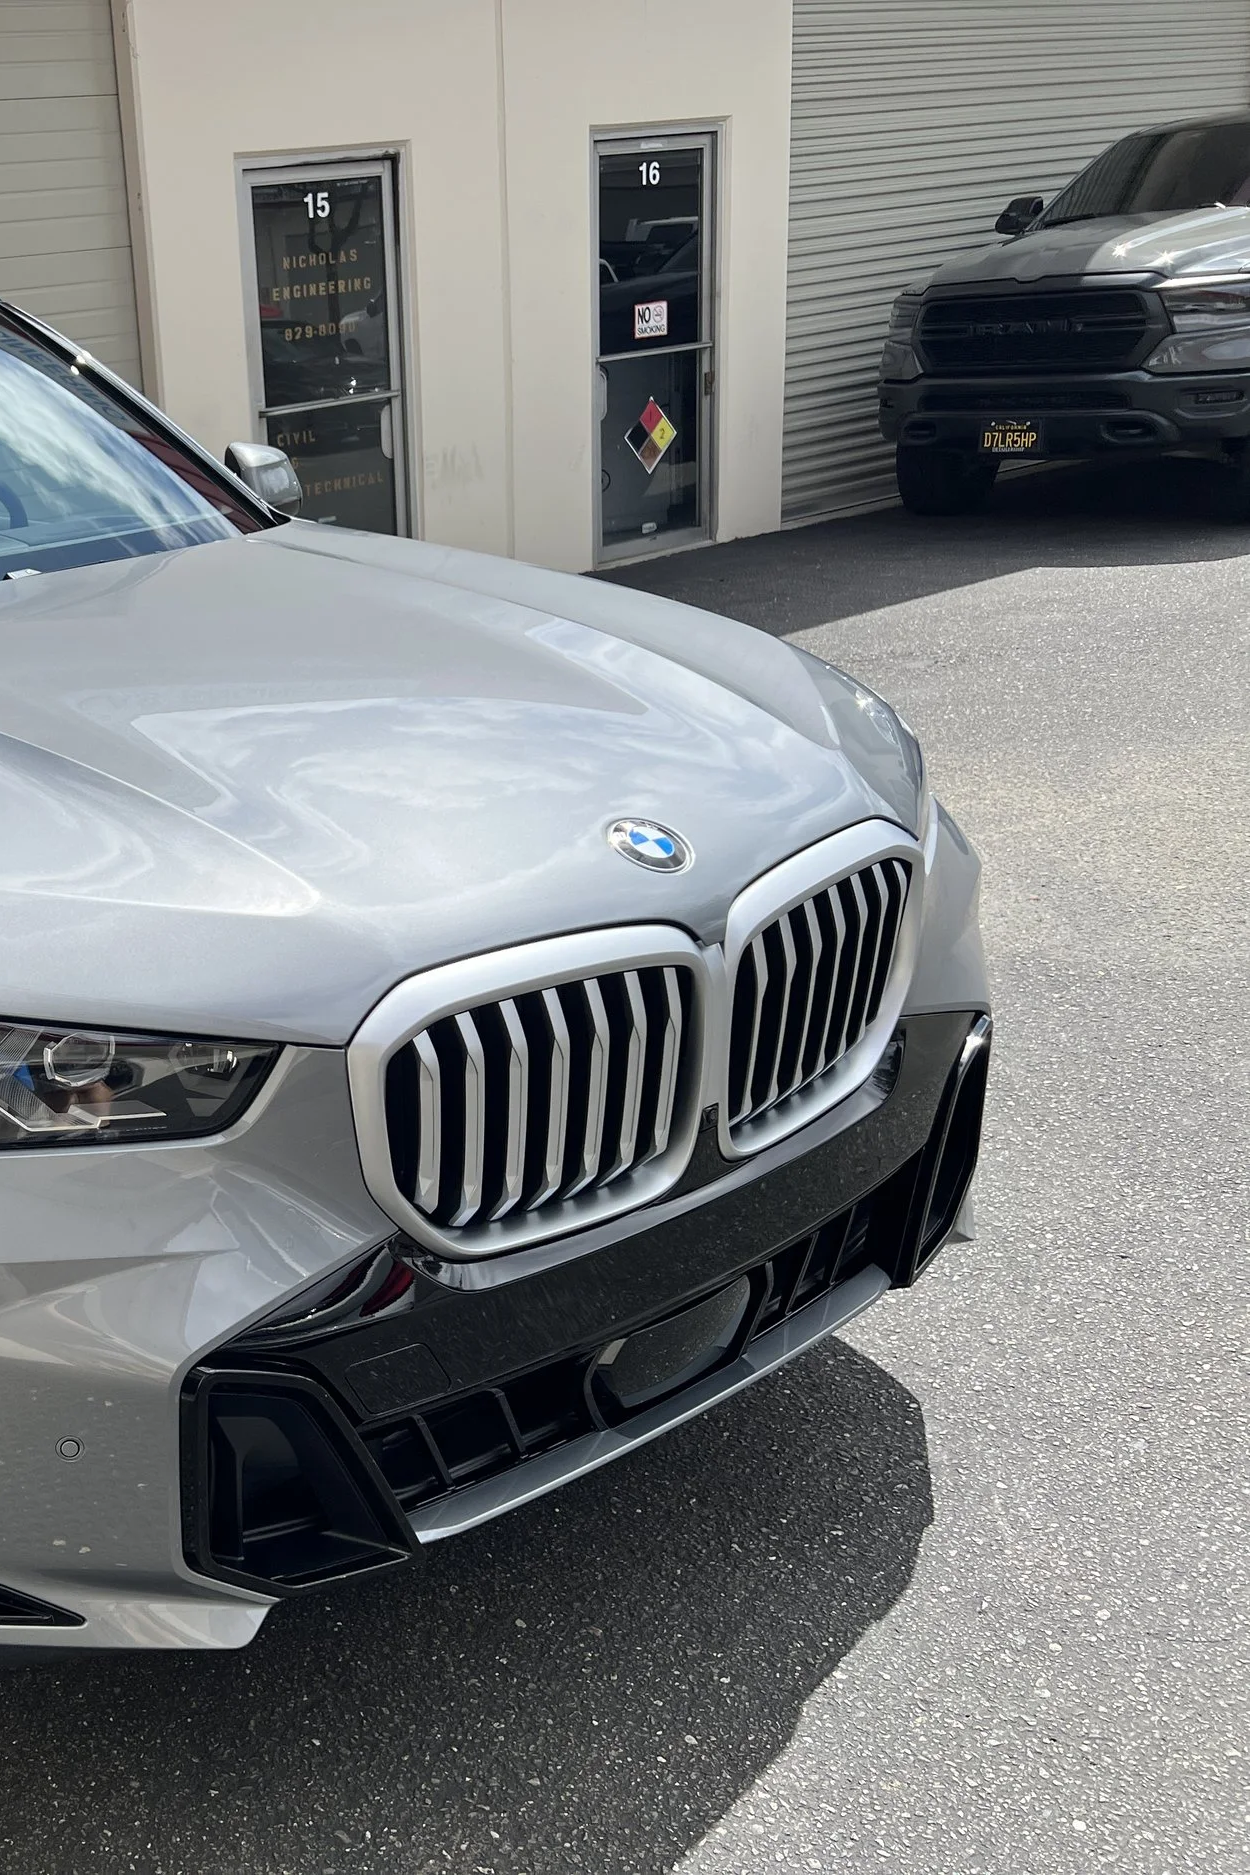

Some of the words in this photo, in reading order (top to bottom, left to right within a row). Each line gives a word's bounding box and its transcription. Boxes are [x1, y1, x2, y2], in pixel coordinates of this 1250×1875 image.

[639, 161, 660, 186] 16
[303, 191, 331, 219] 15
[282, 249, 359, 270] NICHOLAS
[272, 277, 372, 301] ENGINEERING
[637, 306, 652, 325] NO
[636, 323, 666, 336] SMOKING
[276, 429, 316, 447] CIVIL
[983, 431, 1037, 448] D7LR5HP
